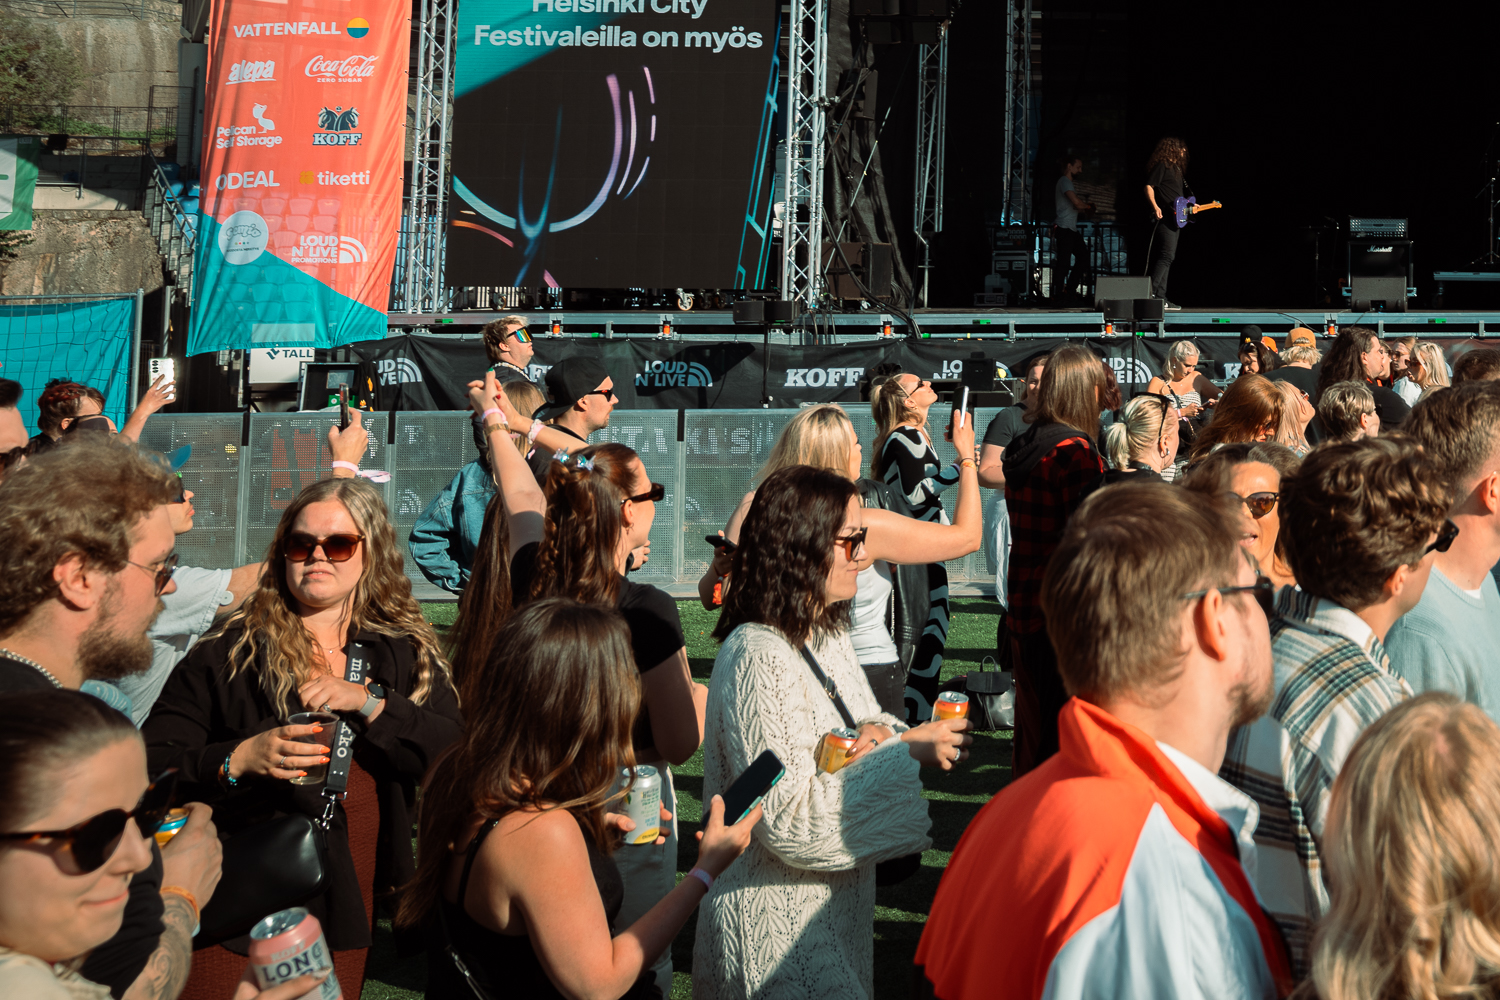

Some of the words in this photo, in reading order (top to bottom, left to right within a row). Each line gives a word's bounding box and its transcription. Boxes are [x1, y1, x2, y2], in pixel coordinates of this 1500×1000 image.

[233, 21, 341, 38] VATTENFALL
[474, 24, 637, 47] Festivaleilla
[642, 29, 679, 48] on
[684, 26, 763, 53] myös
[228, 59, 276, 82] alepa
[304, 55, 379, 77] Coca-Cola
[217, 124, 256, 137] Pelican
[216, 136, 235, 149] Self
[236, 135, 283, 148] Storage
[312, 133, 362, 146] KOFF
[215, 170, 280, 190] ODEAL
[317, 170, 370, 185] tiketti
[300, 235, 338, 246] LOUD
[282, 349, 313, 358] TALL
[644, 360, 688, 374] LOUD
[784, 367, 864, 387] KOFF
[262, 941, 323, 982] LONG
